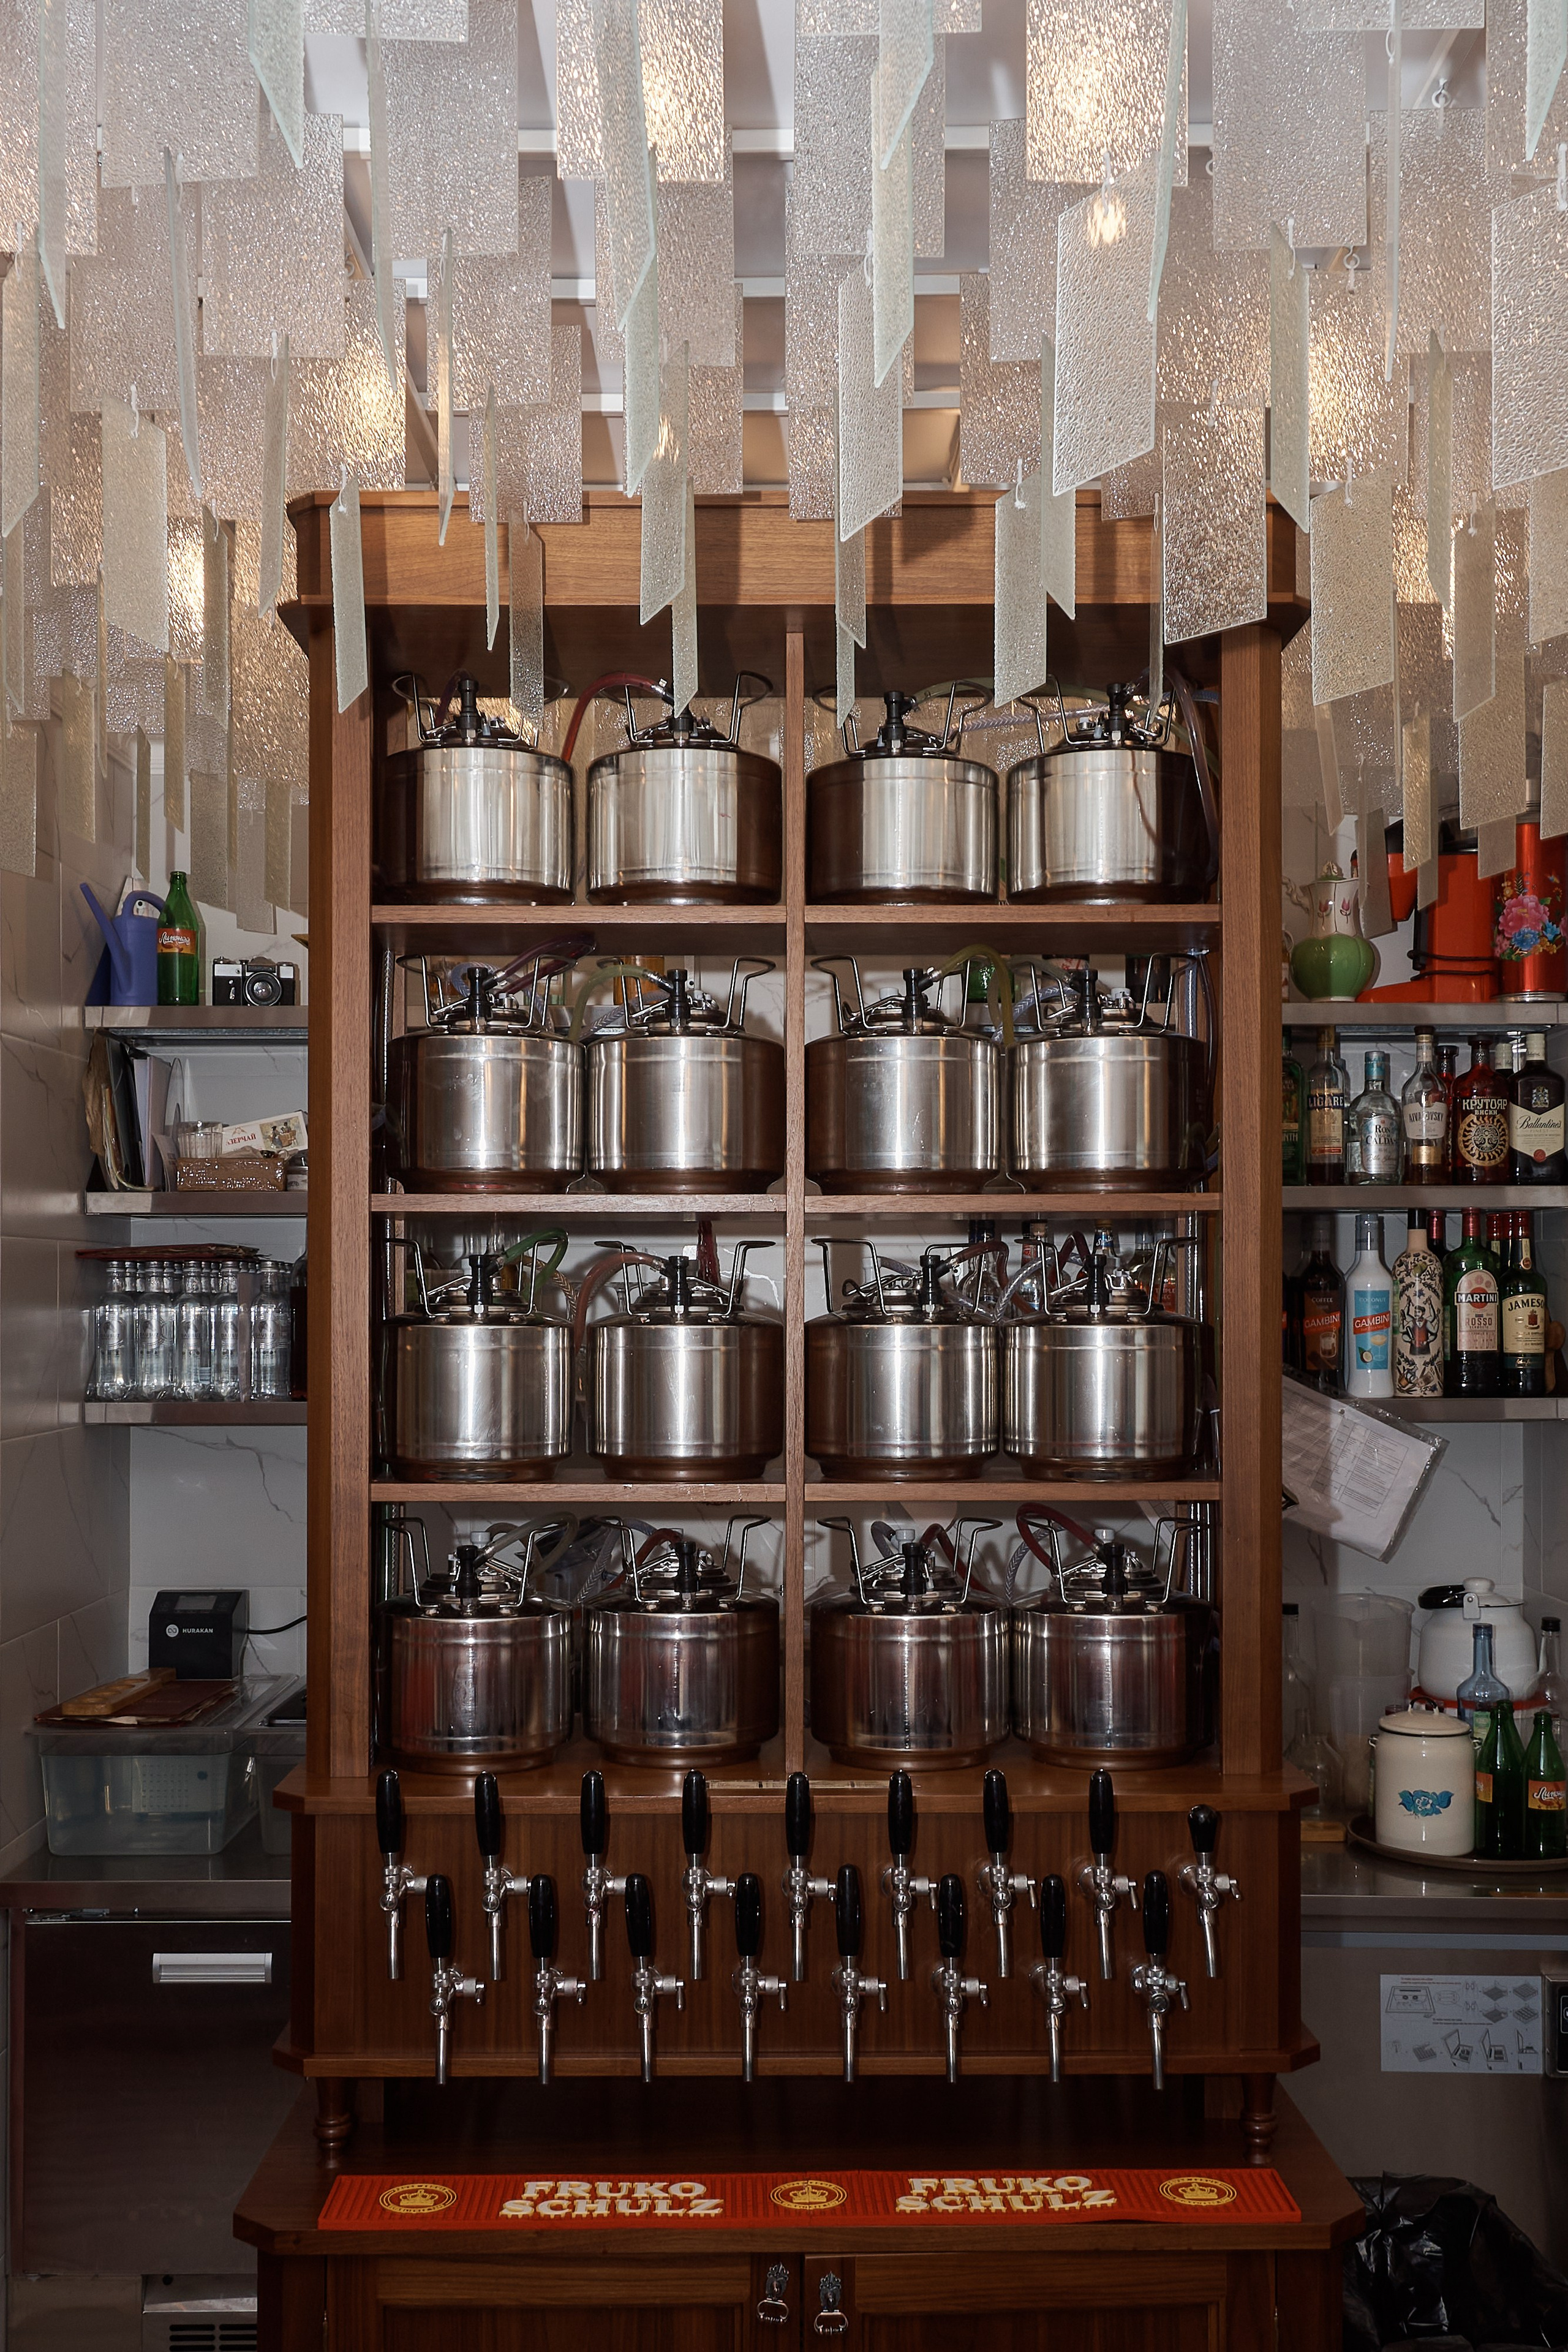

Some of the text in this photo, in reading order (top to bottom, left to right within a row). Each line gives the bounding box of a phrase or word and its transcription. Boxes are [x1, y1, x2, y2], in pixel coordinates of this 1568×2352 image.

[1463, 1099, 1507, 1110] КРУТОЯР
[1409, 1111, 1444, 1123] AIVAOVSKY
[225, 1133, 256, 1145] ЗЕРЧАЙ
[1457, 1293, 1498, 1303] MARTINI
[1305, 1313, 1340, 1329] GAMBINI
[1354, 1313, 1390, 1329] GAMBINI
[1465, 1317, 1492, 1326] ROSSO
[522, 2180, 707, 2199] FRUKO
[910, 2176, 1093, 2196] FRUKO
[499, 2198, 724, 2218] SCHULZ
[896, 2189, 1118, 2213] SCHULZ
